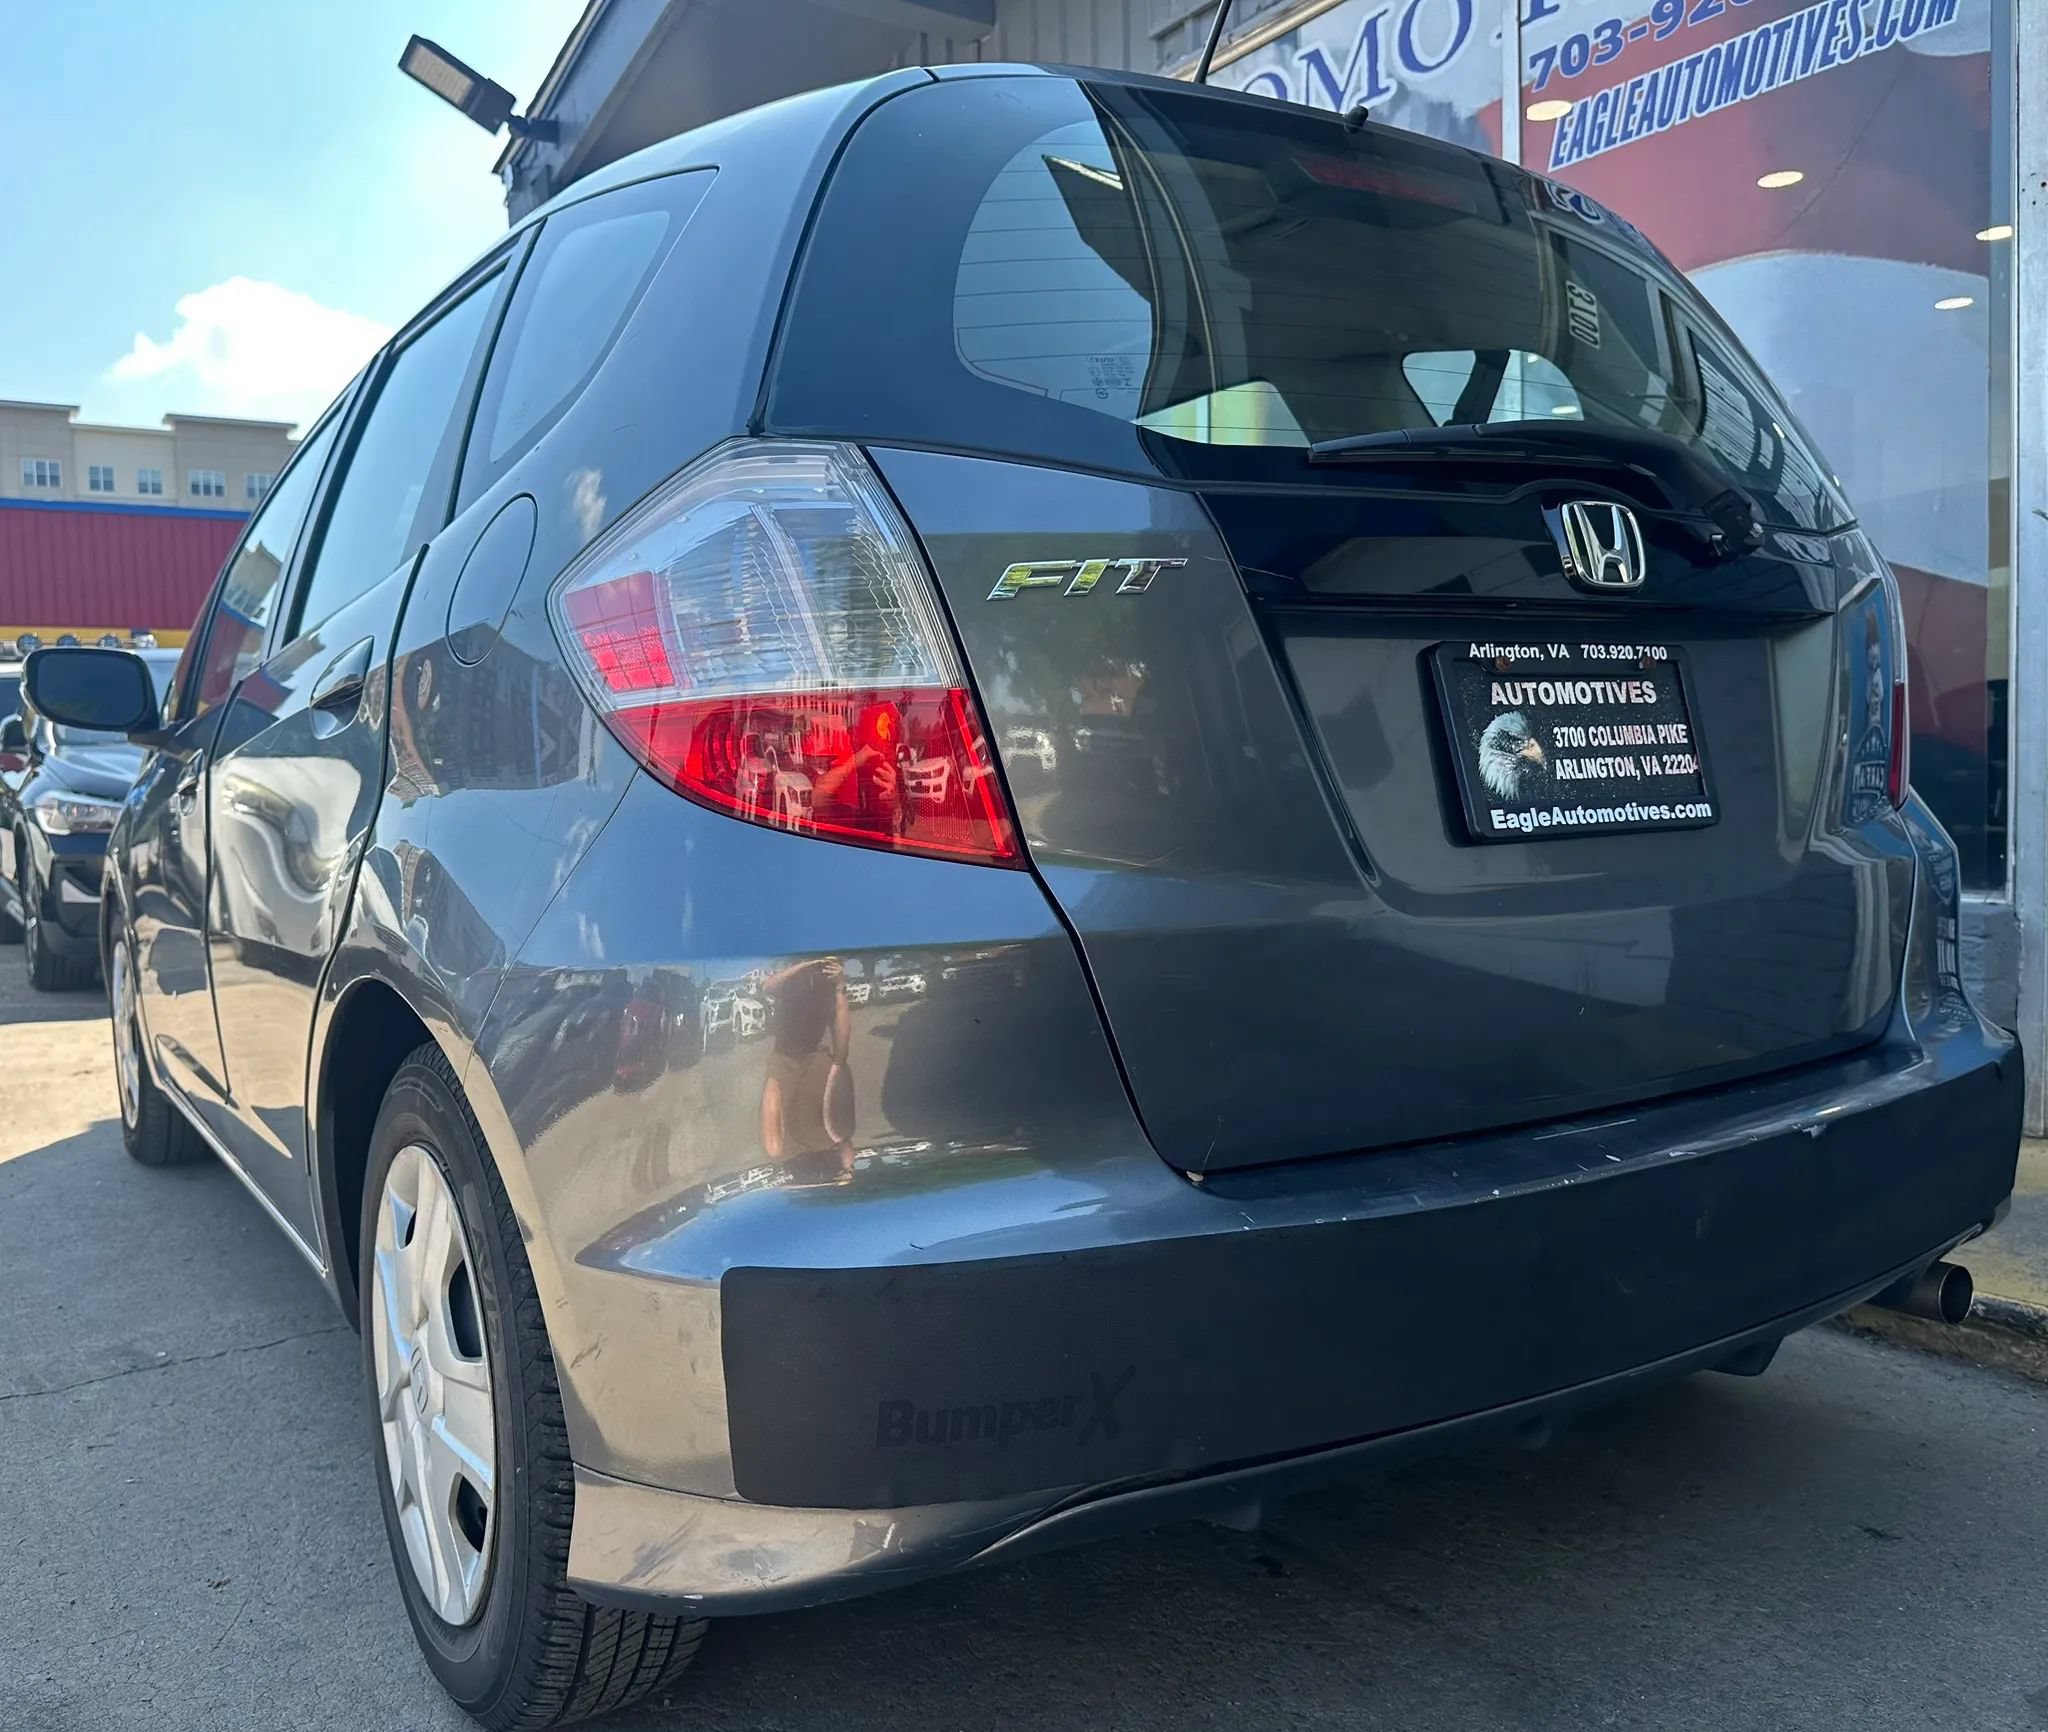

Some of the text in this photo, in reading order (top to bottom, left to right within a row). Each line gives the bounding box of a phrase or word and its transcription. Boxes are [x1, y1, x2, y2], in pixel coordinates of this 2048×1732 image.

[1529, 0, 1752, 93] 703-9
[986, 557, 1188, 601] FIT
[1469, 643, 1668, 662] Arlington, VA 703.920.7100
[1491, 681, 1657, 706] AUTOMOTIVES
[1553, 723, 1688, 748] 3700 COLUMBIA PIKE
[1555, 756, 1641, 781] ARLINGTON,
[1640, 755, 1662, 777] VA
[1490, 801, 1712, 833] EagleAutomotives.com
